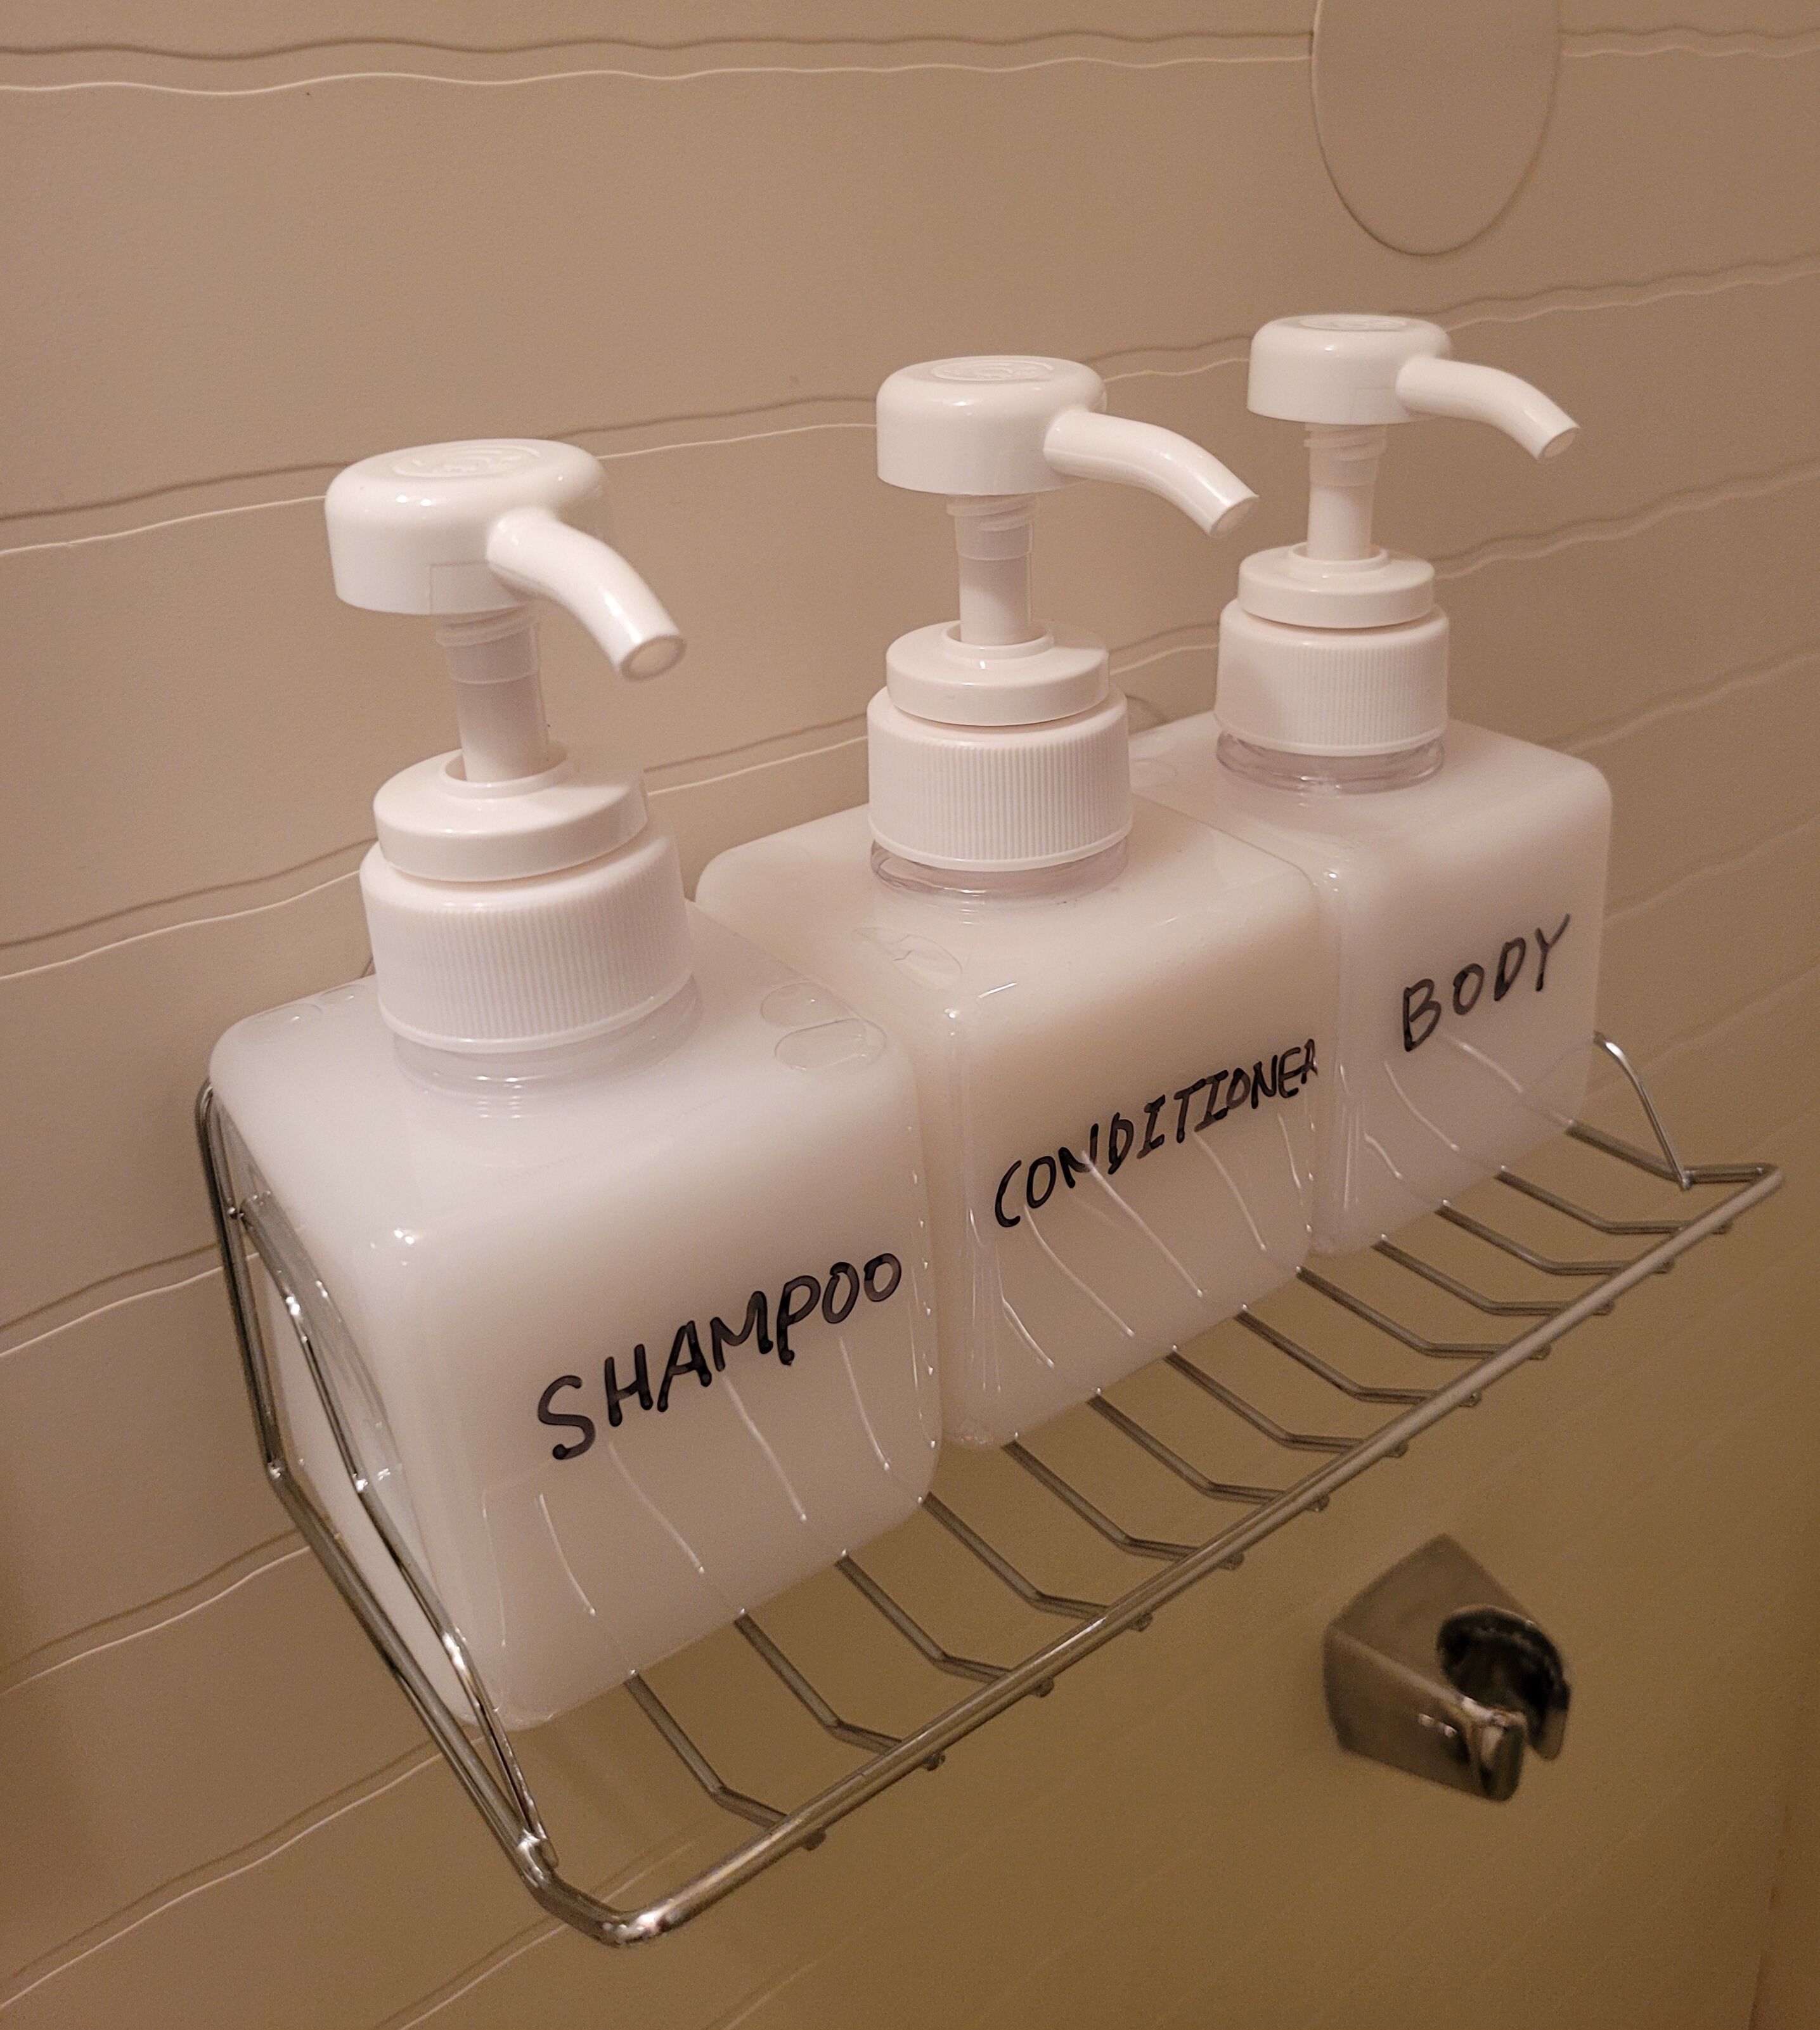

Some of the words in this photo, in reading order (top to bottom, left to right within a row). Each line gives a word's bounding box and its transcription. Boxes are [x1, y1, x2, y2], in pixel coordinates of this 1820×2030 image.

[1403, 913, 1571, 1052] BODY
[995, 1038, 1318, 1227] CONDITIONER
[538, 1253, 901, 1460] SHAMPOO
